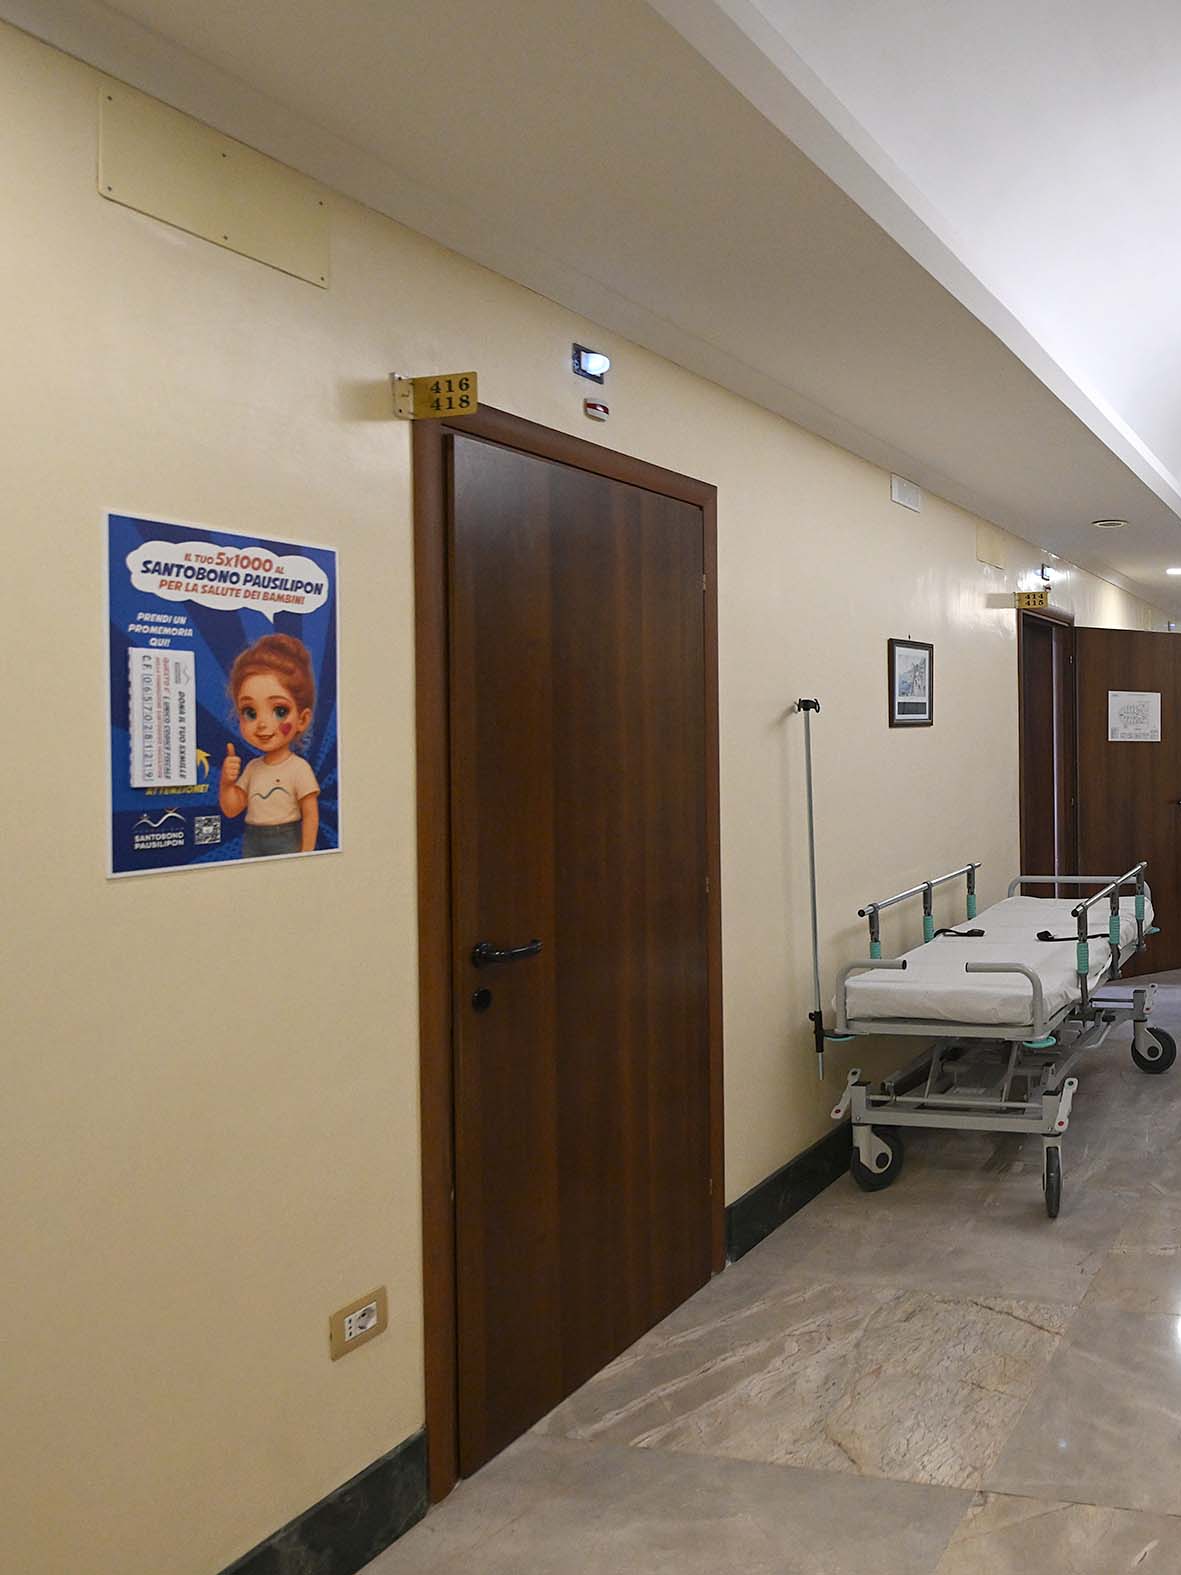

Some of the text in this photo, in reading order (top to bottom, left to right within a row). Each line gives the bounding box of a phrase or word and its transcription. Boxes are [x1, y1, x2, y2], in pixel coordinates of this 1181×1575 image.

[430, 377, 470, 394] 416
[430, 394, 470, 411] 418
[184, 551, 285, 574] IL TUO 5x1000 AL
[141, 560, 324, 595] SANTOBONO PAUSILIPON
[159, 578, 182, 592] PER
[184, 582, 199, 593] LA
[200, 584, 241, 598] SALUTE
[243, 589, 261, 600] DEI
[137, 612, 187, 625] PRENDI UN
[128, 624, 193, 637] PROMEMORIA
[133, 839, 185, 850] PAUSILIPON
[134, 831, 185, 842] SANTOBONO
